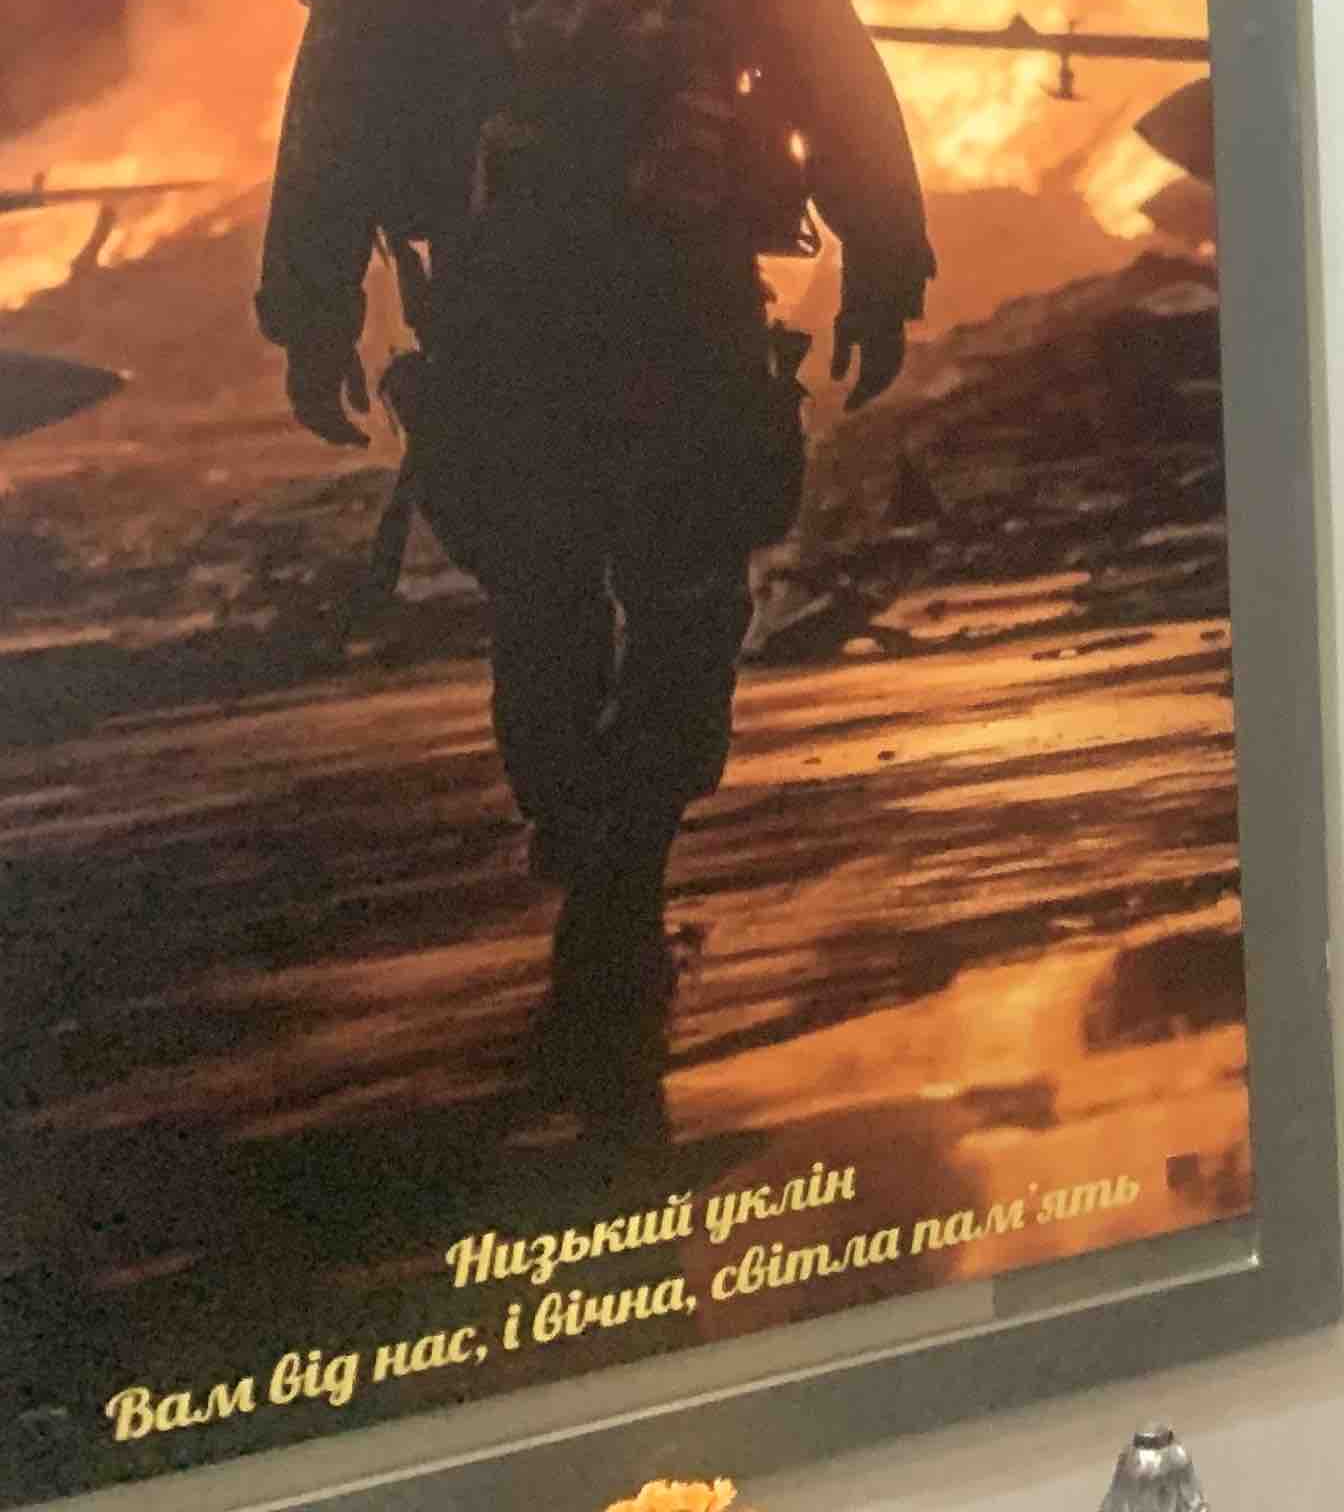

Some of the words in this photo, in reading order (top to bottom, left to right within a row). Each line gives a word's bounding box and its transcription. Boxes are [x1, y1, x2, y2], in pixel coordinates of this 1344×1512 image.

[445, 1191, 694, 1288] Низький
[704, 1161, 857, 1244] уклін
[105, 1375, 256, 1441] Вам
[267, 1349, 359, 1407] від
[372, 1325, 488, 1382] нас,
[503, 1303, 521, 1350] і
[532, 1276, 697, 1343] вічна,
[710, 1225, 901, 1301] світла
